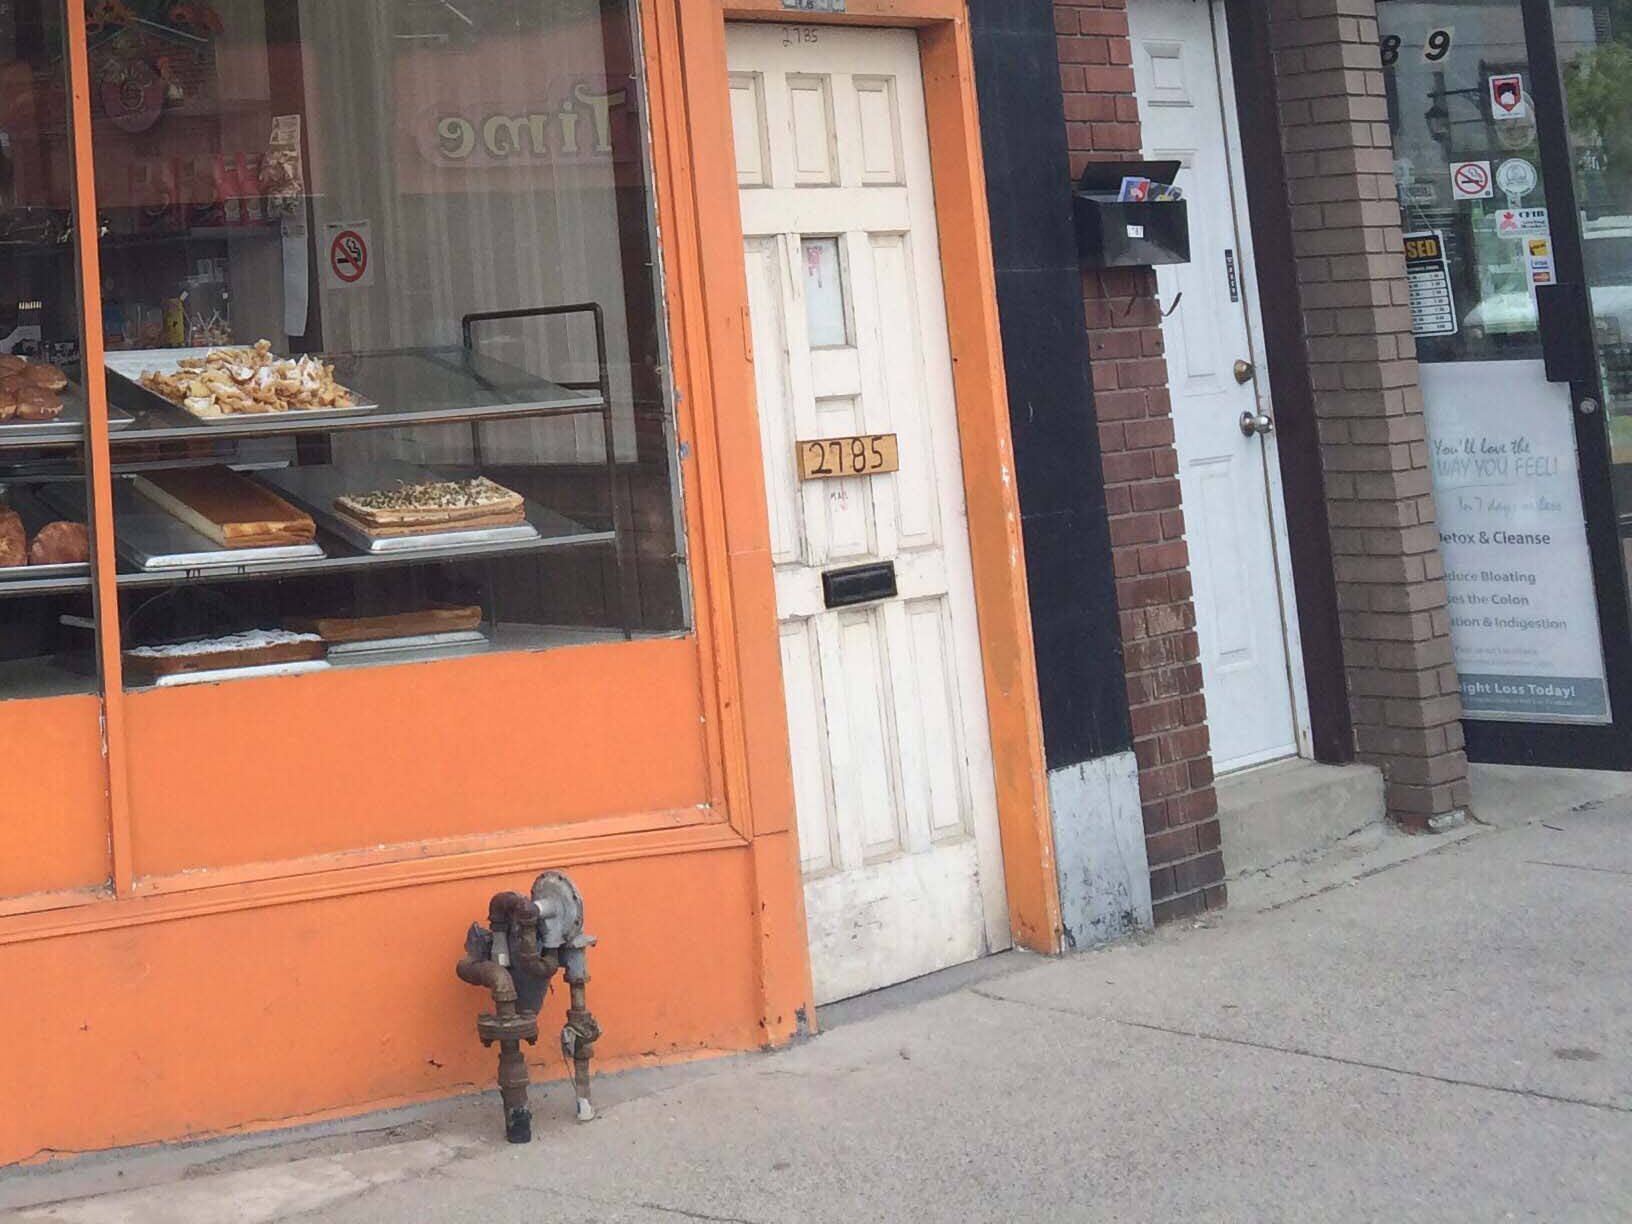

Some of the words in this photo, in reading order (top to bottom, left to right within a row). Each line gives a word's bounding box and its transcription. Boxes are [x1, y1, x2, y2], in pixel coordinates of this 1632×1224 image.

[1407, 239, 1437, 258] SED
[1434, 437, 1476, 455] You'll
[1511, 436, 1530, 454] the
[809, 436, 883, 474] 2785
[1474, 457, 1508, 476] YOU
[1479, 531, 1490, 544] &
[1493, 531, 1550, 544] Cleanse
[1480, 571, 1536, 585] Bloating
[1492, 594, 1529, 605] Colon
[1483, 617, 1493, 627] &
[1495, 617, 1567, 631] Indigestion
[1462, 681, 1491, 696] ight
[1495, 683, 1525, 695] Loss
[1528, 684, 1576, 699] Today!
